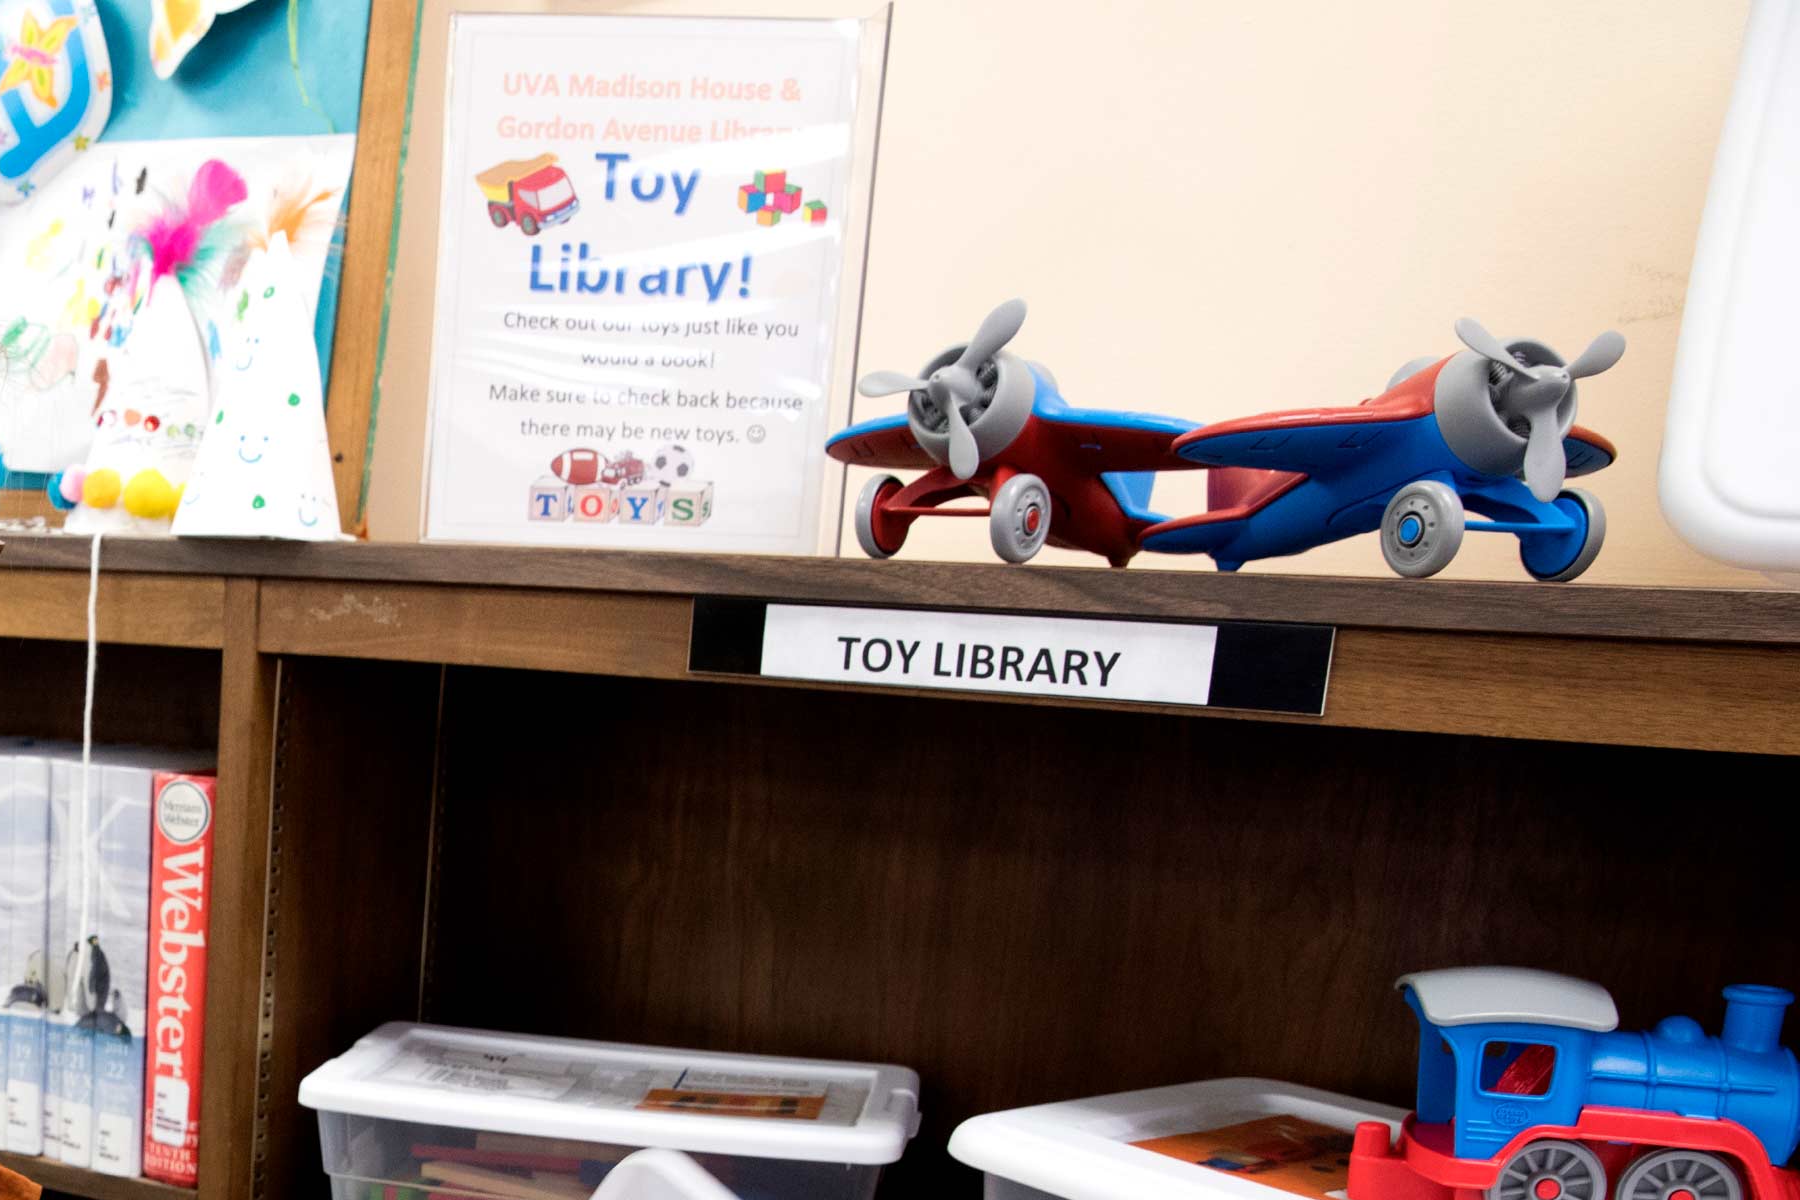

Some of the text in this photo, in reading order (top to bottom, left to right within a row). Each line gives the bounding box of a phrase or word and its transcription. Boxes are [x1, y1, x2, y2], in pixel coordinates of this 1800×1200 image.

[503, 73, 802, 101] UVA Madison House &
[497, 115, 595, 141] Gordon
[603, 118, 703, 143] Avenue
[595, 152, 701, 215] Toy
[529, 242, 753, 303] Library!
[503, 311, 559, 330] Check
[566, 317, 596, 331] out
[685, 319, 720, 337] just
[726, 319, 758, 336] like
[765, 322, 799, 339] you
[489, 384, 540, 402] Make
[546, 387, 586, 404] sure
[617, 387, 670, 406] check
[677, 389, 719, 408] back
[726, 391, 803, 410] because
[520, 419, 739, 444] there may be new toys.
[536, 492, 695, 521] TOYS
[837, 635, 1121, 688] TOY LIBRARY
[104, 1062, 125, 1079] 22
